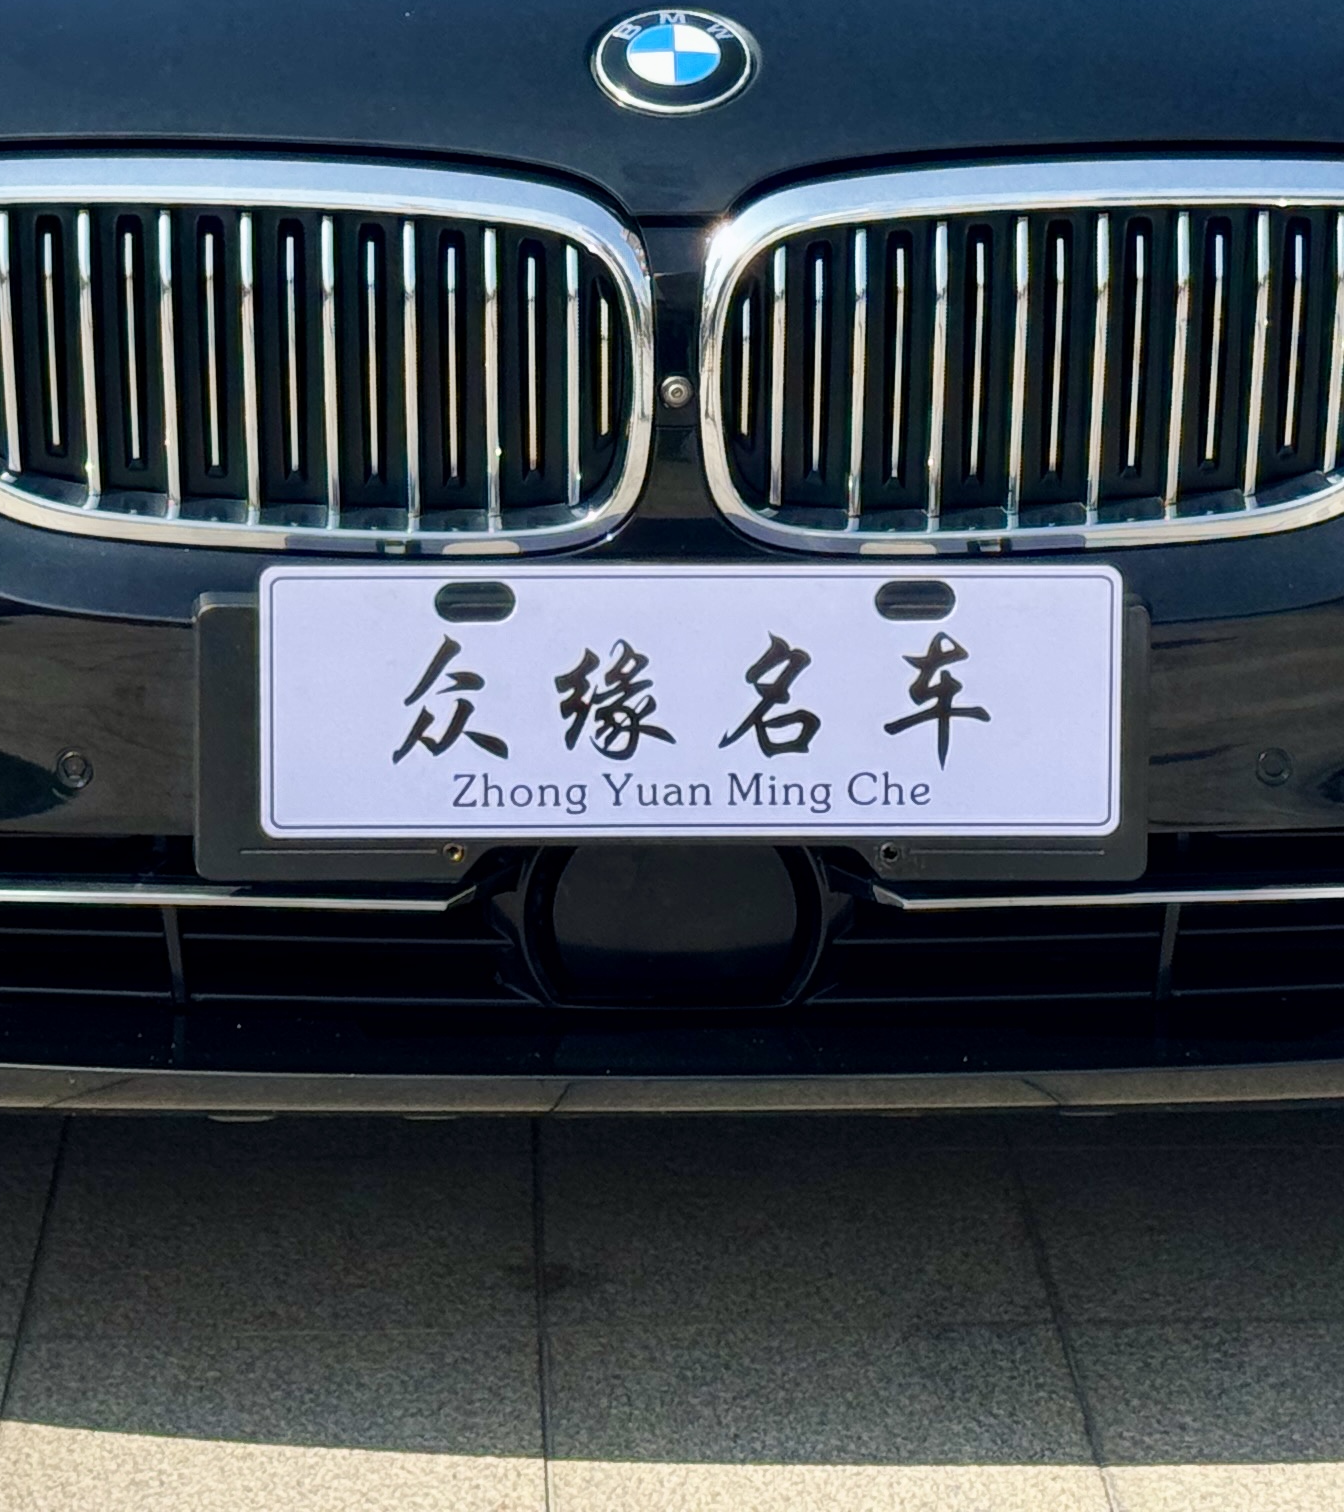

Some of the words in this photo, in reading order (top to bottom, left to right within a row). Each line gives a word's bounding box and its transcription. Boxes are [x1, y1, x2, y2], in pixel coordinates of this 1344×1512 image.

[612, 12, 734, 41] BMW
[393, 632, 991, 769] 众缘名车
[453, 774, 587, 814] Zhong
[602, 773, 712, 806] Yuan
[727, 773, 831, 813] Ming
[847, 772, 931, 806] Che
